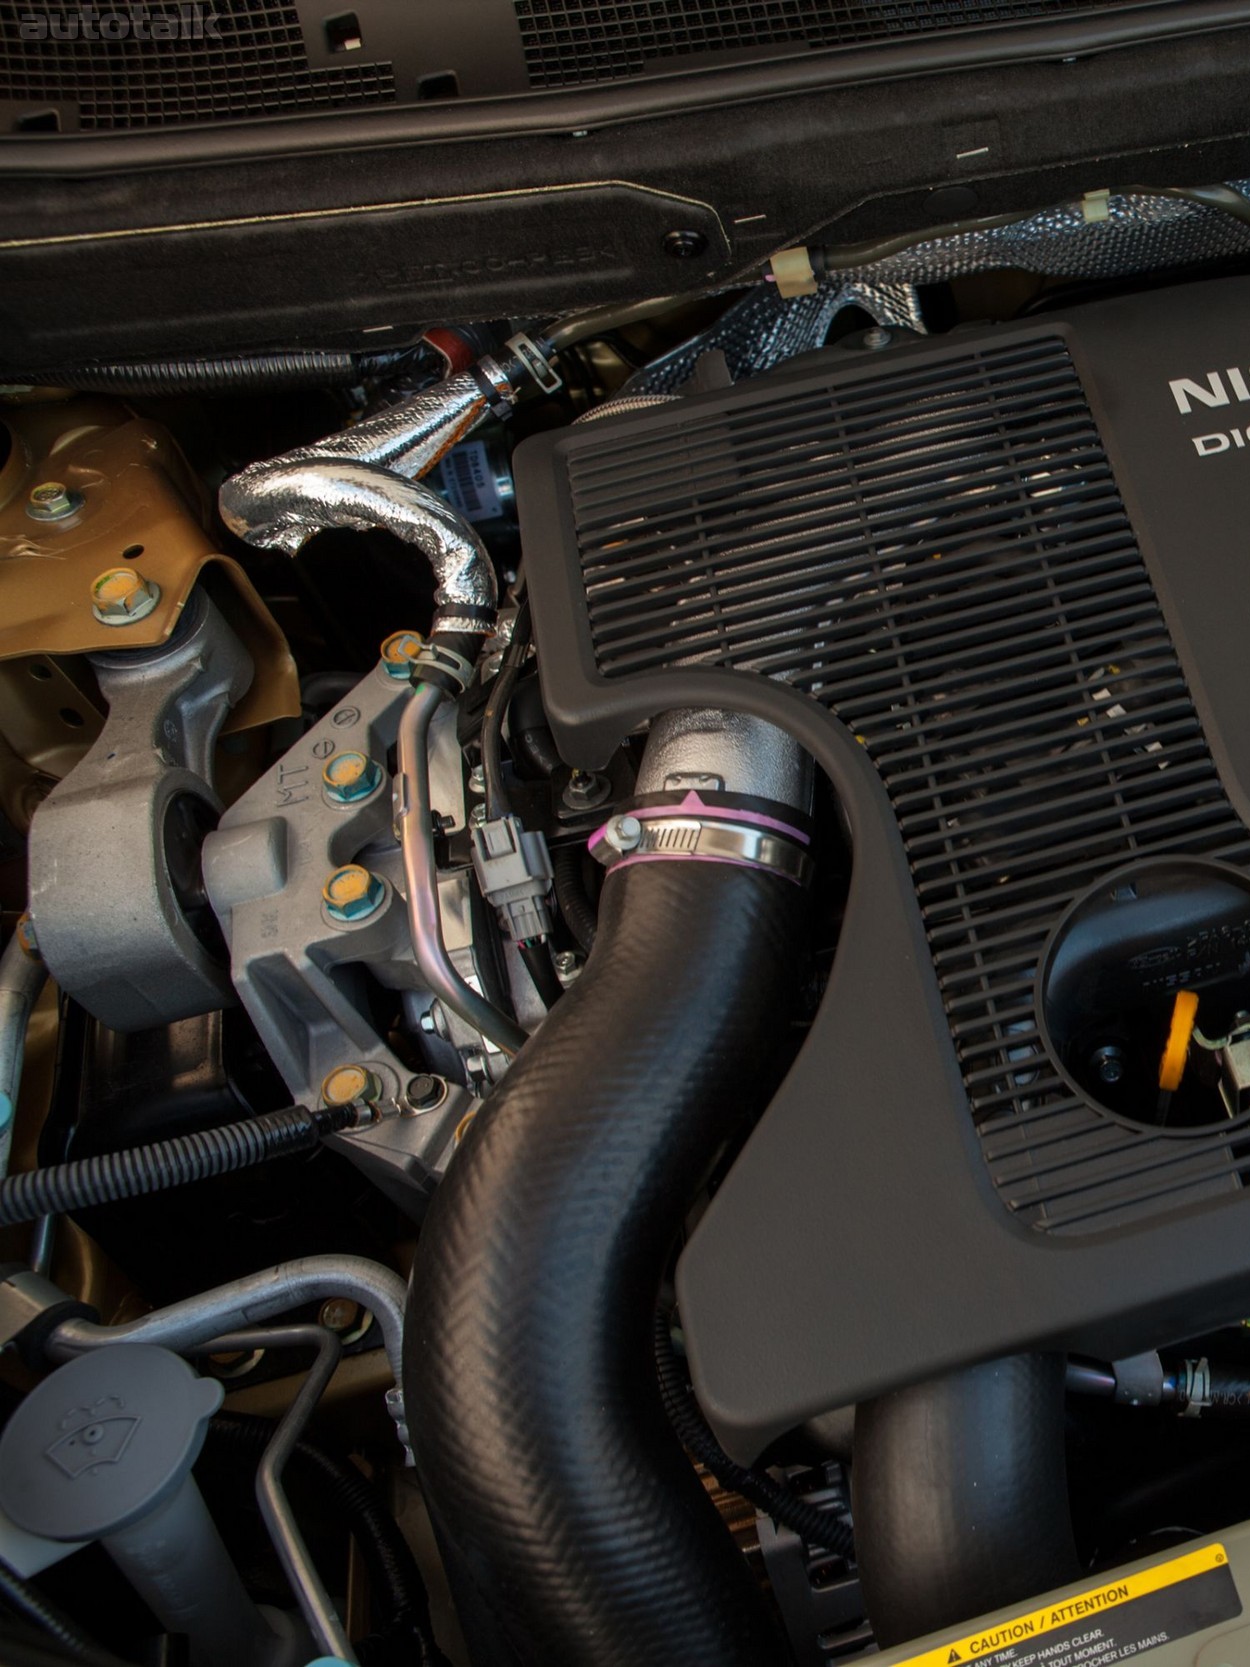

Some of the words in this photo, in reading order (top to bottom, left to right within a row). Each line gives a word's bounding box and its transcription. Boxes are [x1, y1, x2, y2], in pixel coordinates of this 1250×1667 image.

[970, 1620, 1034, 1654] CAUTION
[1050, 1585, 1129, 1625] ATTENTION
[994, 1648, 1018, 1664] TIME.
[1037, 1641, 1071, 1660] HANDS
[1071, 1629, 1104, 1648] CLEAR.
[1048, 1653, 1073, 1667] TOUT
[1074, 1638, 1117, 1661] MOMENT.
[1118, 1643, 1137, 1658] LES
[1137, 1631, 1170, 1651] MAINS.
